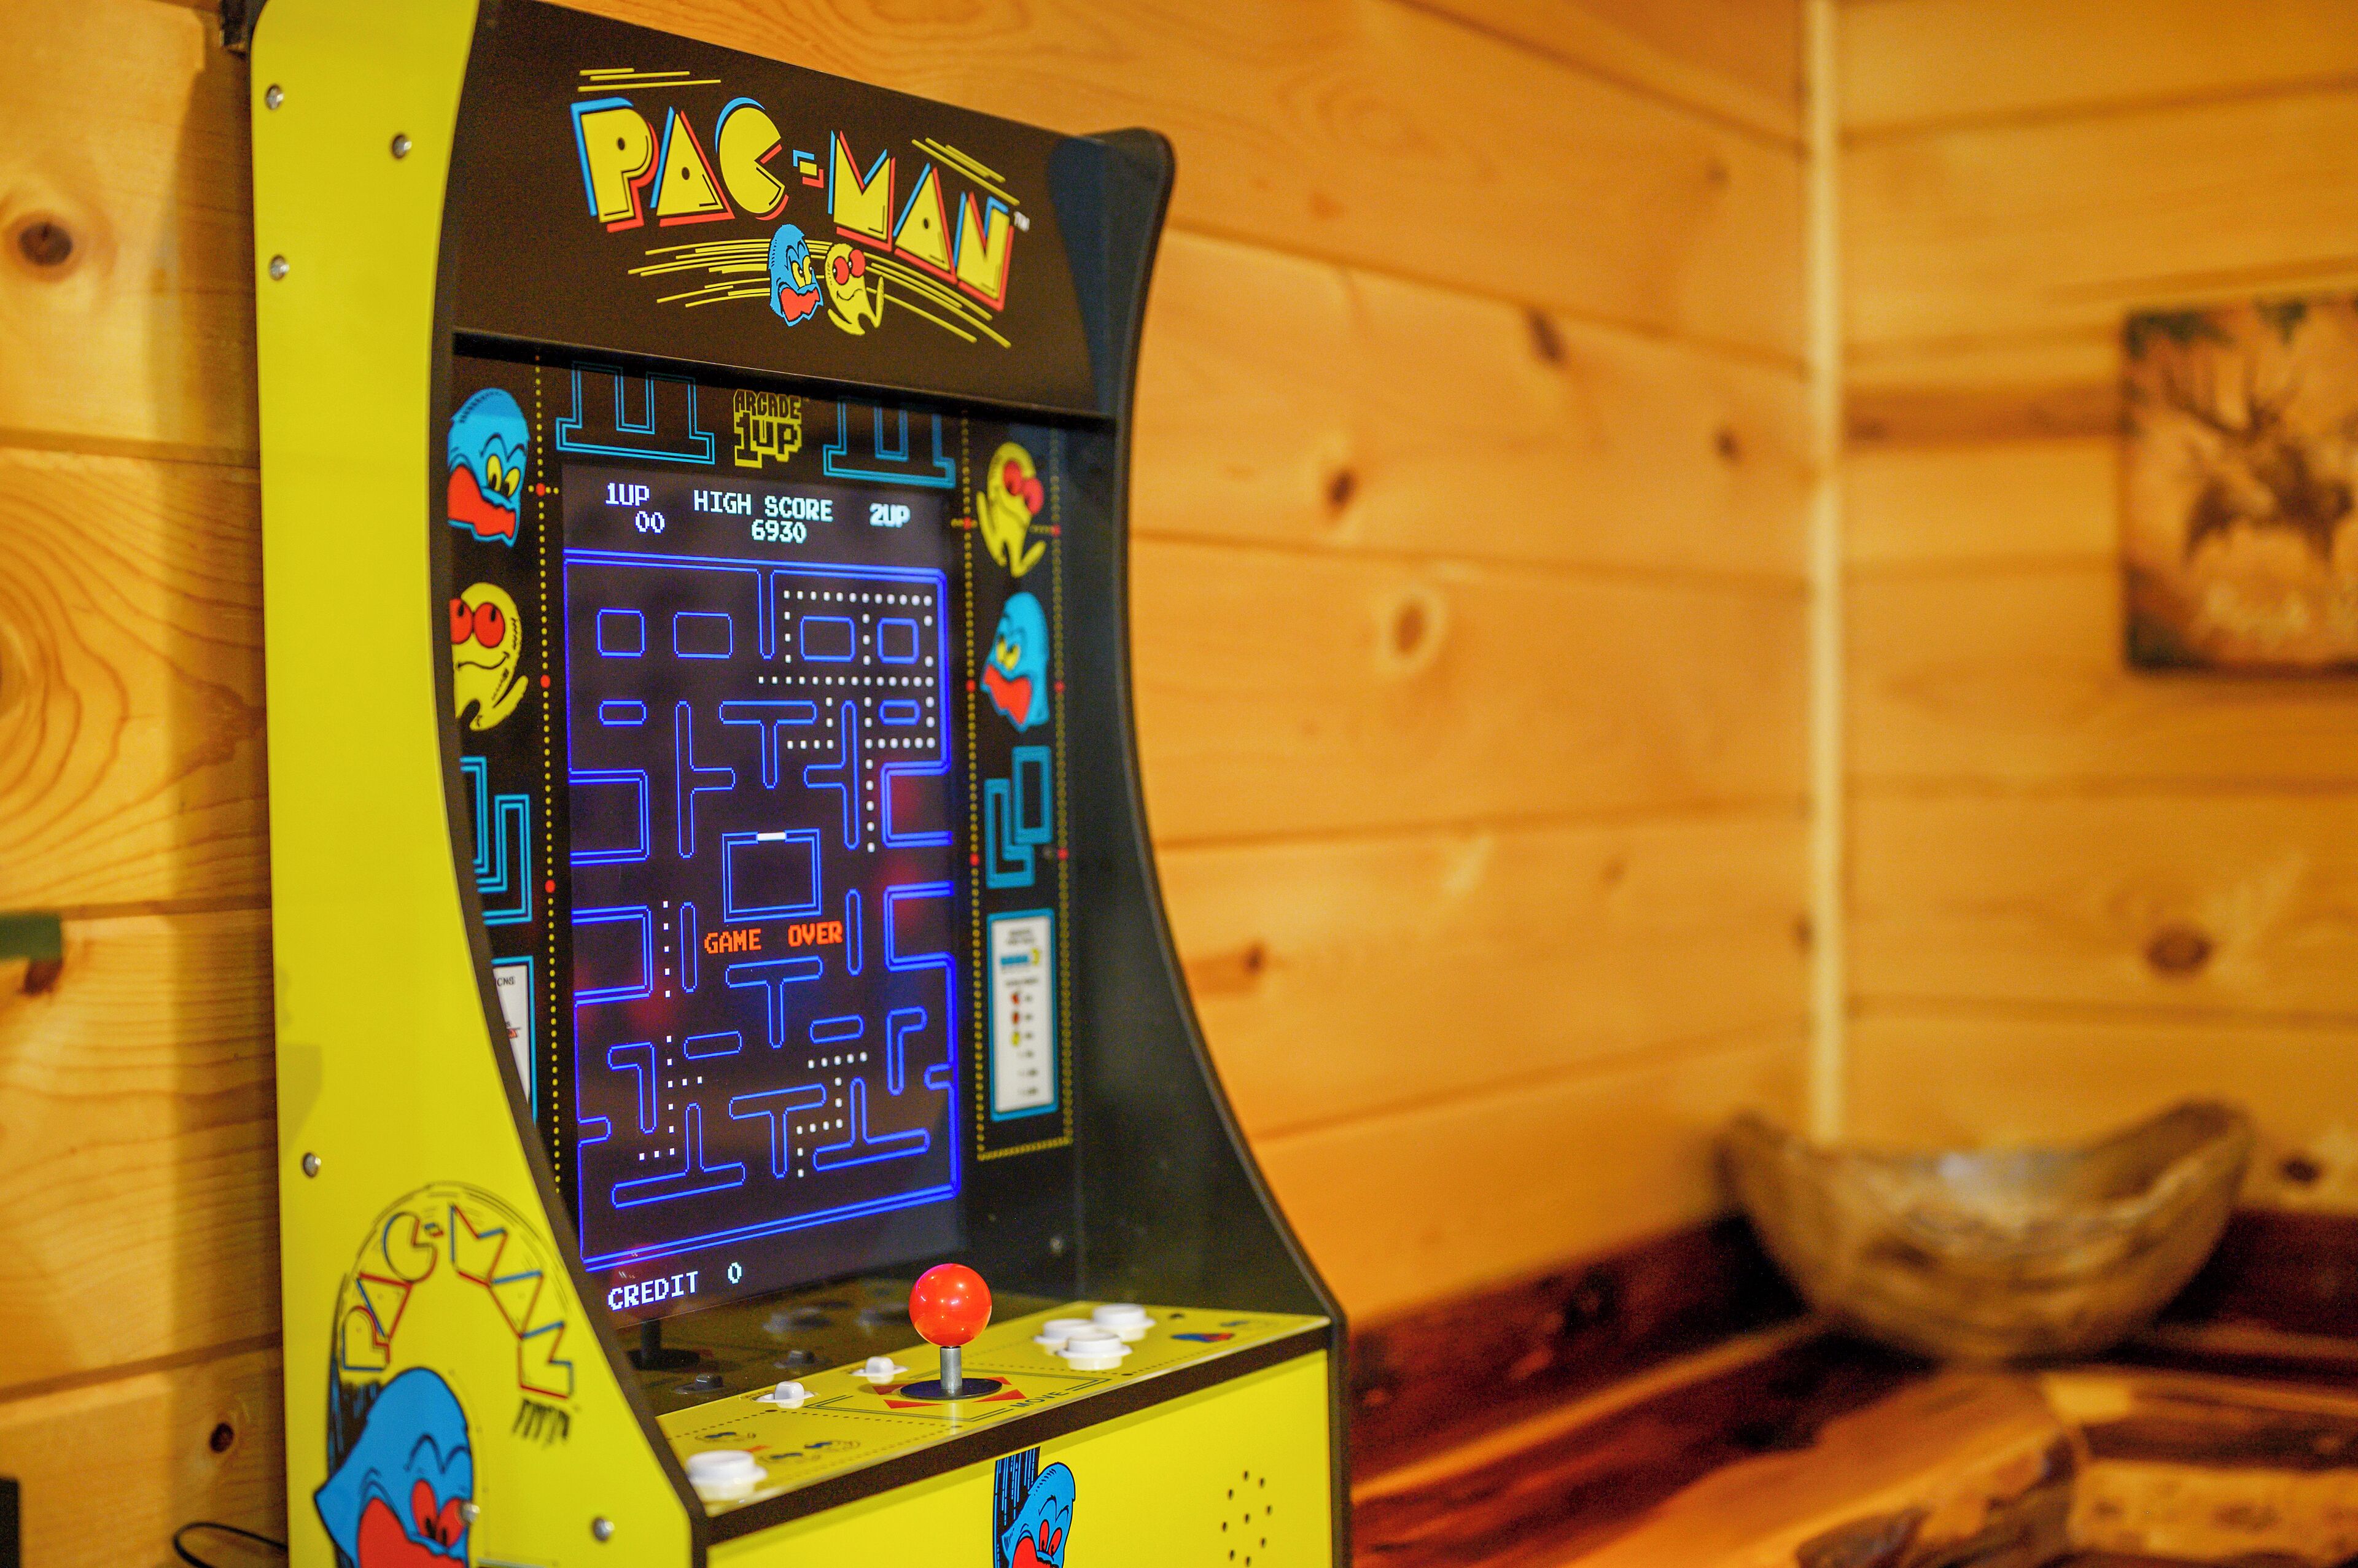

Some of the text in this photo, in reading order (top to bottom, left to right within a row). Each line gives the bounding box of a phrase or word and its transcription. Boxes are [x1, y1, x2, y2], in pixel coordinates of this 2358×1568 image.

[570, 97, 1015, 311] PAC-MAN
[733, 389, 801, 420] ARCADE
[605, 483, 650, 506] 1UP
[694, 490, 833, 522] HIGH SCORE
[635, 510, 666, 534] 00
[870, 503, 911, 528] 2UP
[752, 519, 807, 544] 6930
[704, 921, 843, 954] GAME OVER
[608, 1262, 742, 1311] CREDIT 0
[1010, 1391, 1070, 1408] MOVE
